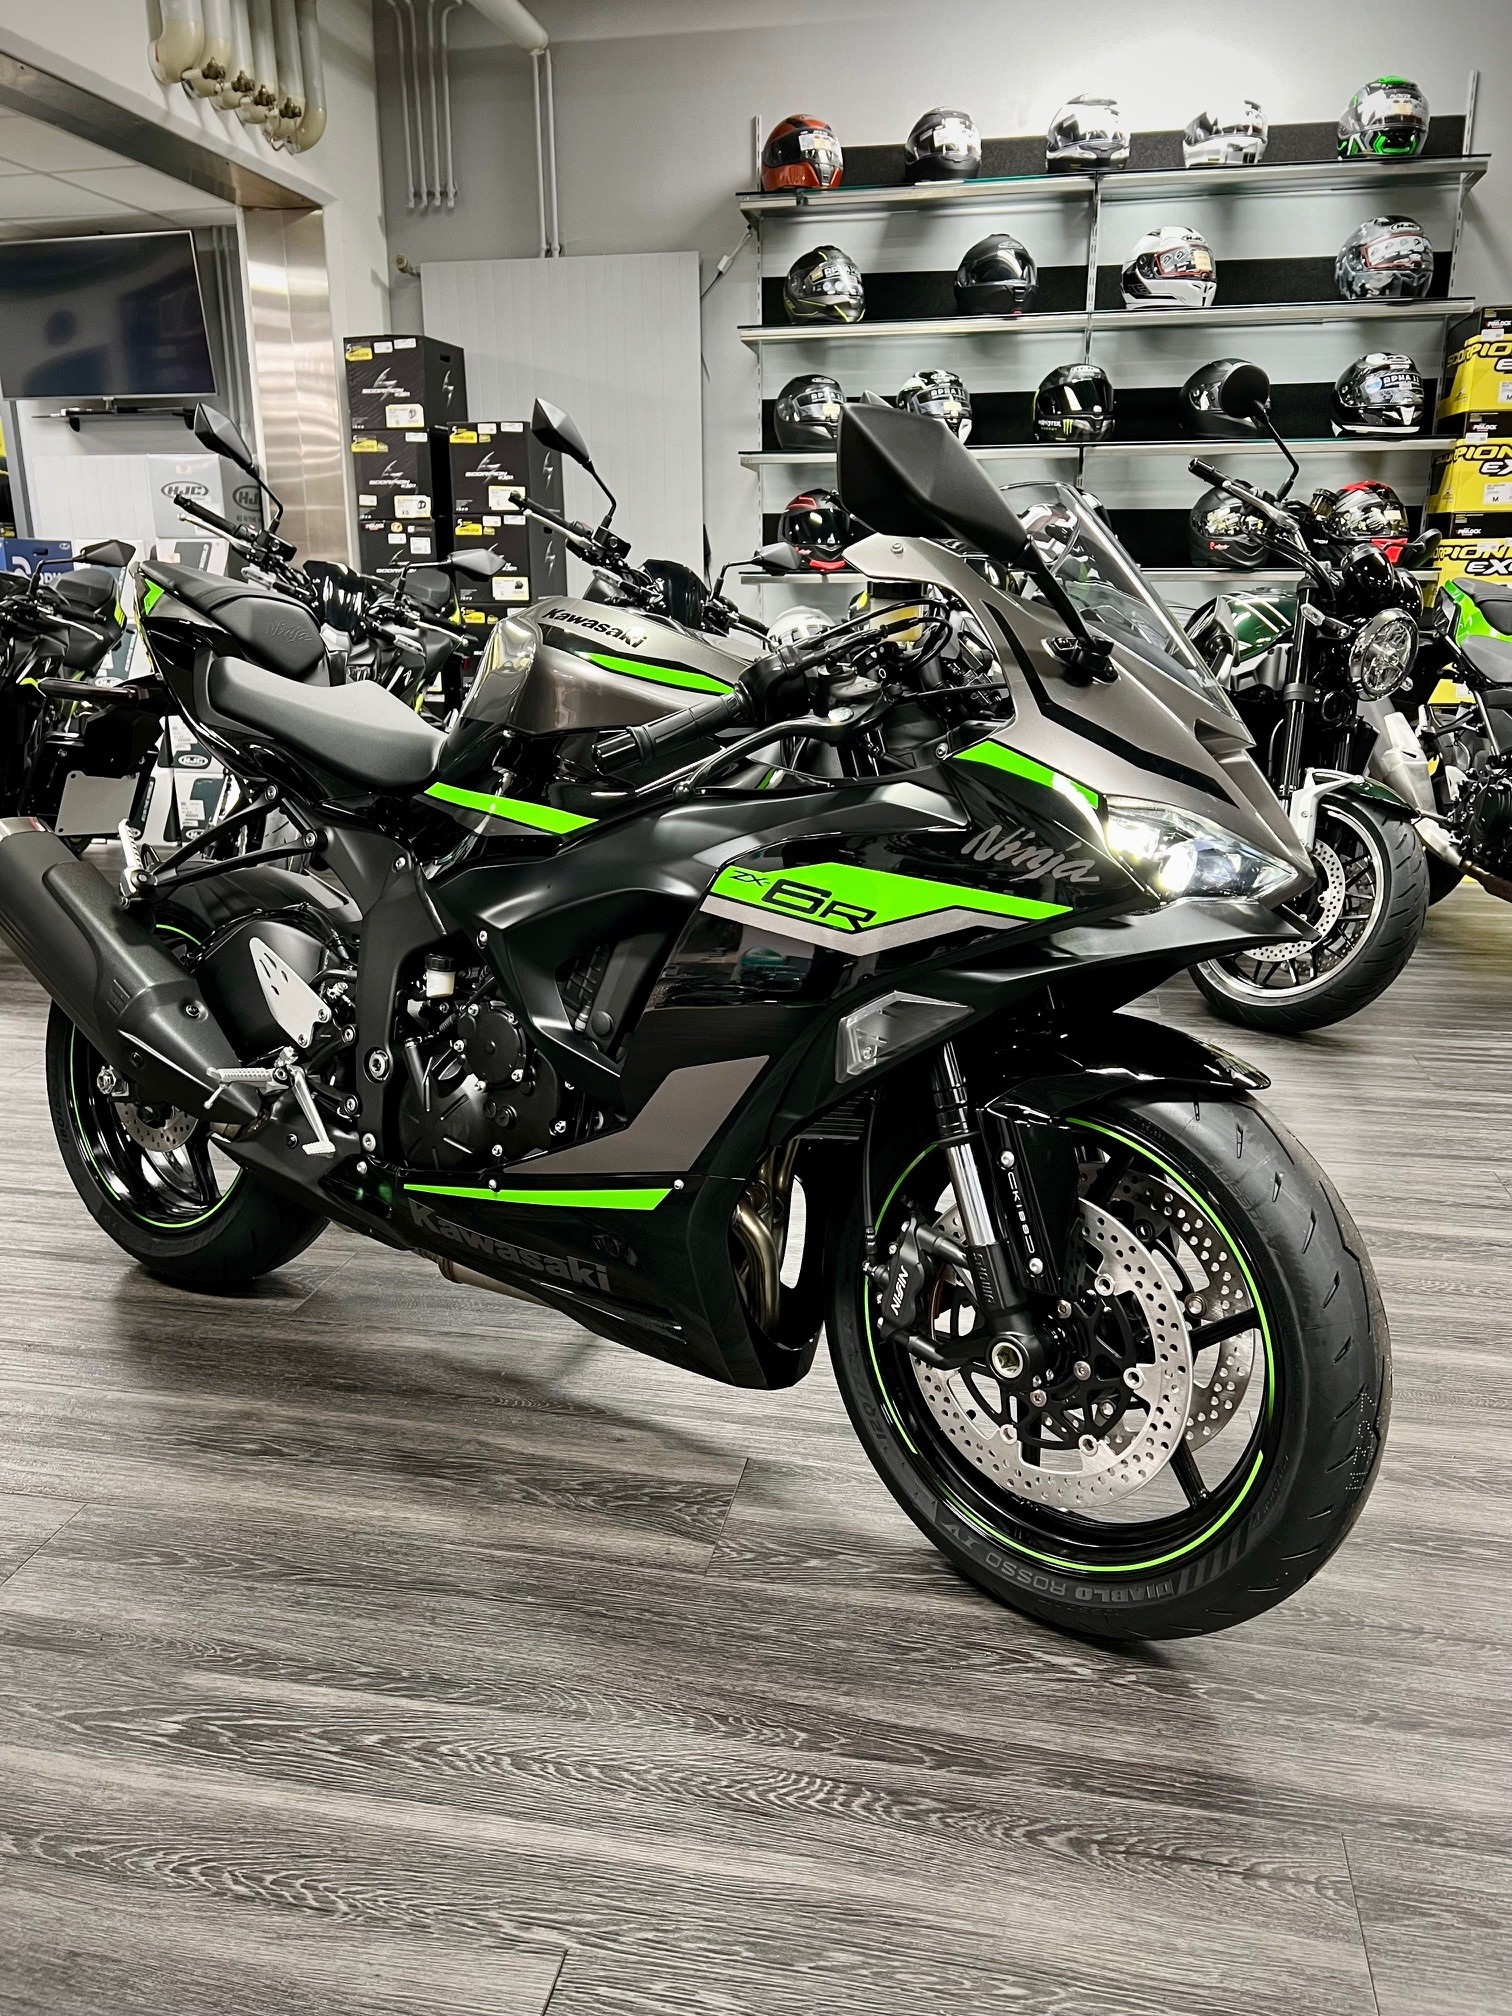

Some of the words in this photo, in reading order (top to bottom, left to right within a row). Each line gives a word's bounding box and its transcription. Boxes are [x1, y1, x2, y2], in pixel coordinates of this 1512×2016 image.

[1382, 374, 1411, 384] RPHA
[542, 608, 648, 649] Kawasaki
[961, 825, 1100, 882] Ninja
[408, 1197, 613, 1292] Kawasaki
[890, 1264, 909, 1317] NISSIN
[985, 1551, 1066, 1596] ROSSO
[1075, 1578, 1174, 1603] DIABLO
